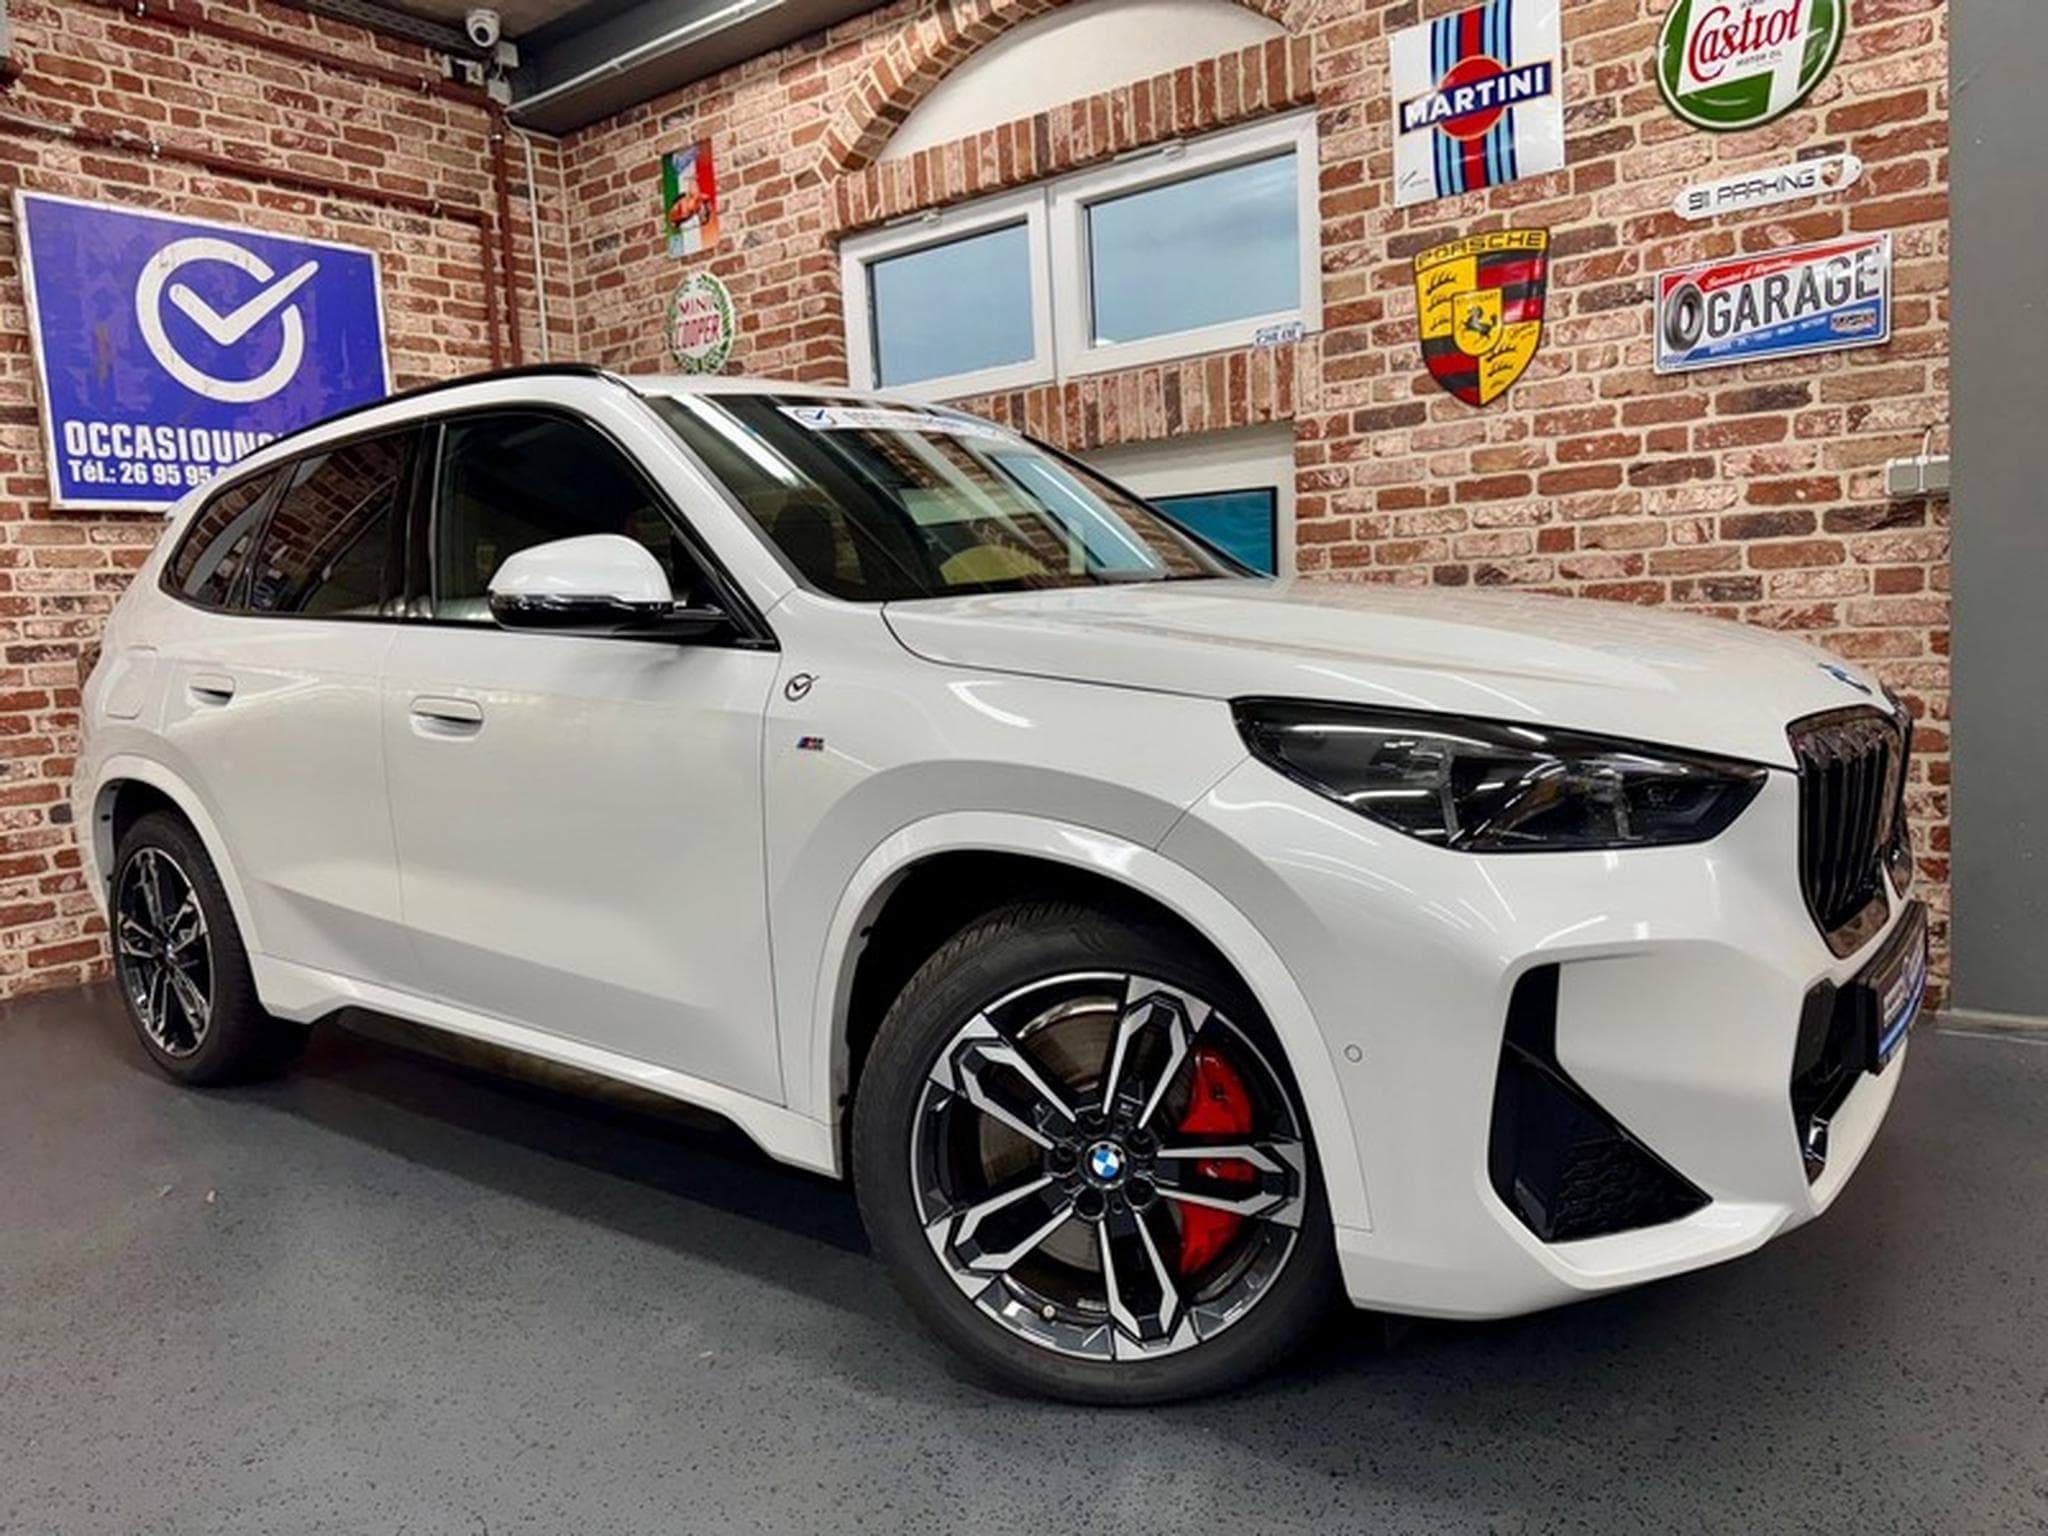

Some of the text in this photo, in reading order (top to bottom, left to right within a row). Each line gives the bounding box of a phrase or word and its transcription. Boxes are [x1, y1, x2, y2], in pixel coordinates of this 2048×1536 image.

[1689, 0, 1801, 82] Castrol
[1404, 66, 1545, 129] MARTINI
[1718, 168, 1815, 205] PARKING
[1417, 232, 1543, 267] PORSCHE
[1706, 246, 1880, 338] GARAGE
[63, 420, 283, 464] OCCASIOUN
[119, 462, 149, 486] 26
[152, 462, 182, 486] 95
[185, 464, 212, 487] 95
